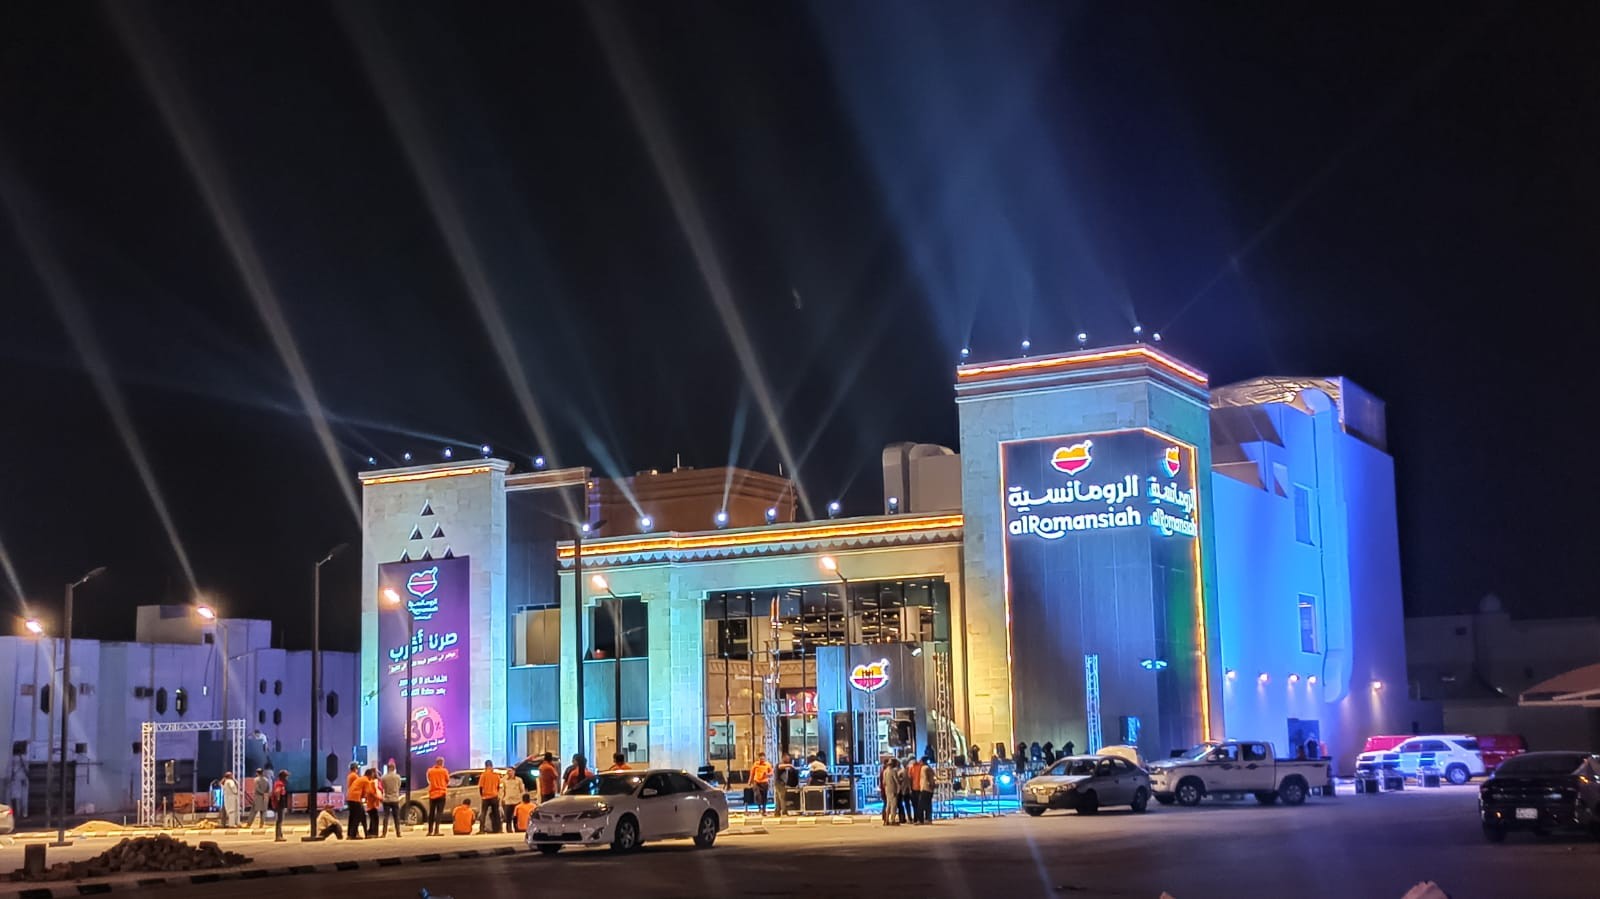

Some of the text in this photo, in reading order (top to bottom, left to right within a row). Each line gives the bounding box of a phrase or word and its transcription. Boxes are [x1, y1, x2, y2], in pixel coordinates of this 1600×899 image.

[1008, 475, 1138, 512] الرومانسية
[1009, 507, 1141, 539] alRomansiah
[389, 629, 458, 662] صرنا أقرب
